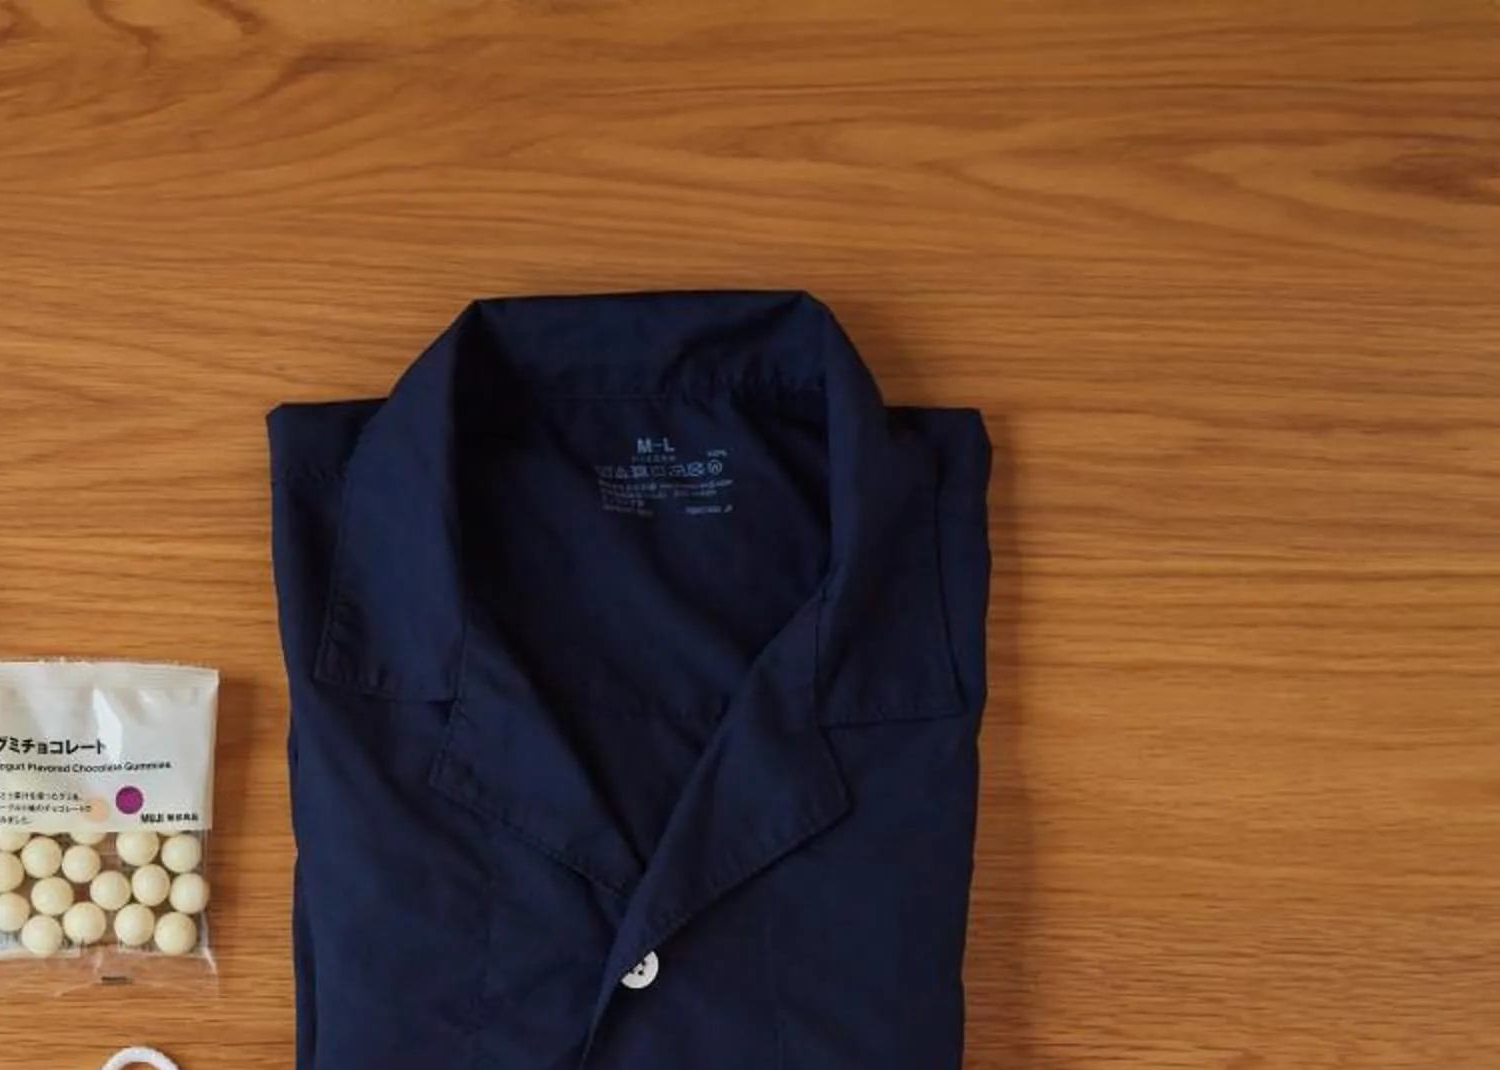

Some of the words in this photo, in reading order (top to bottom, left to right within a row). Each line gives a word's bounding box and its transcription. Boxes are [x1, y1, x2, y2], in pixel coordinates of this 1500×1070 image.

[636, 437, 676, 453] M-L
[28, 763, 71, 773] Flavored
[73, 762, 122, 773] Chocolate
[124, 761, 171, 771] Gummies
